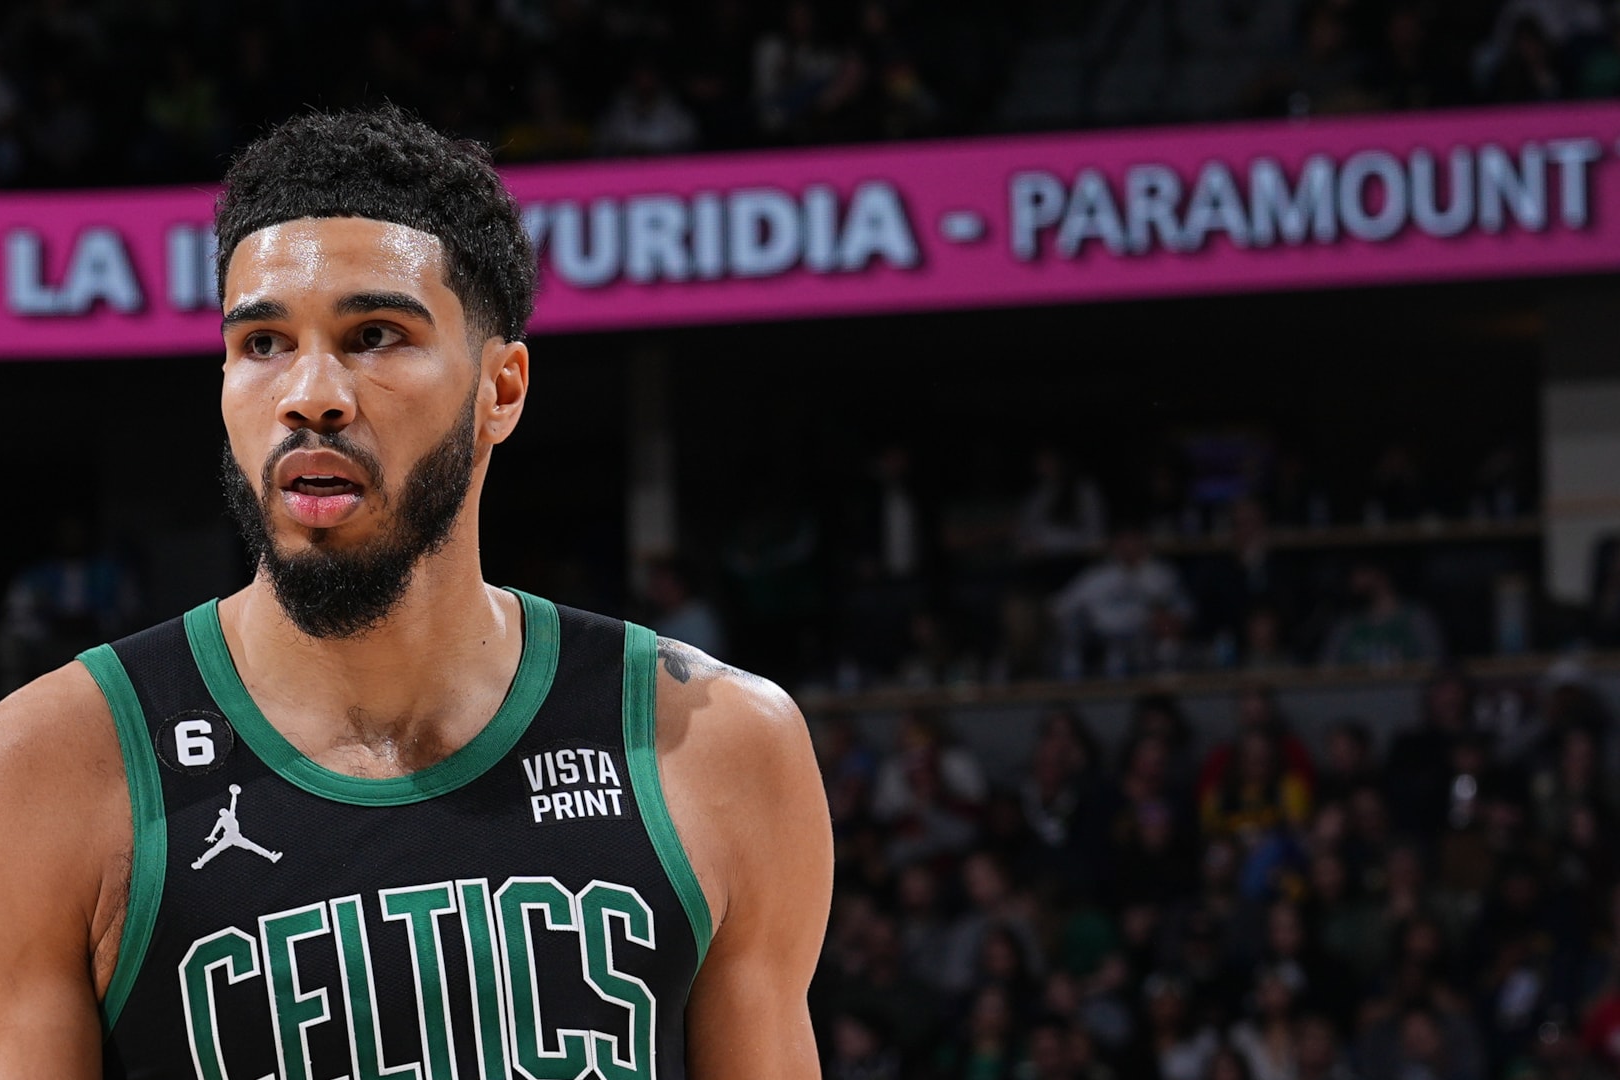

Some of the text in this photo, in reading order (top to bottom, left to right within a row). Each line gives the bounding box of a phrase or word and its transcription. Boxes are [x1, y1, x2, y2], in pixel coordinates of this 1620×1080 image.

[1010, 138, 1602, 260] PARAMOUNT
[5, 229, 142, 314] LA
[175, 719, 216, 767] 6
[522, 749, 620, 792] VISTA
[531, 789, 623, 823] PRINT
